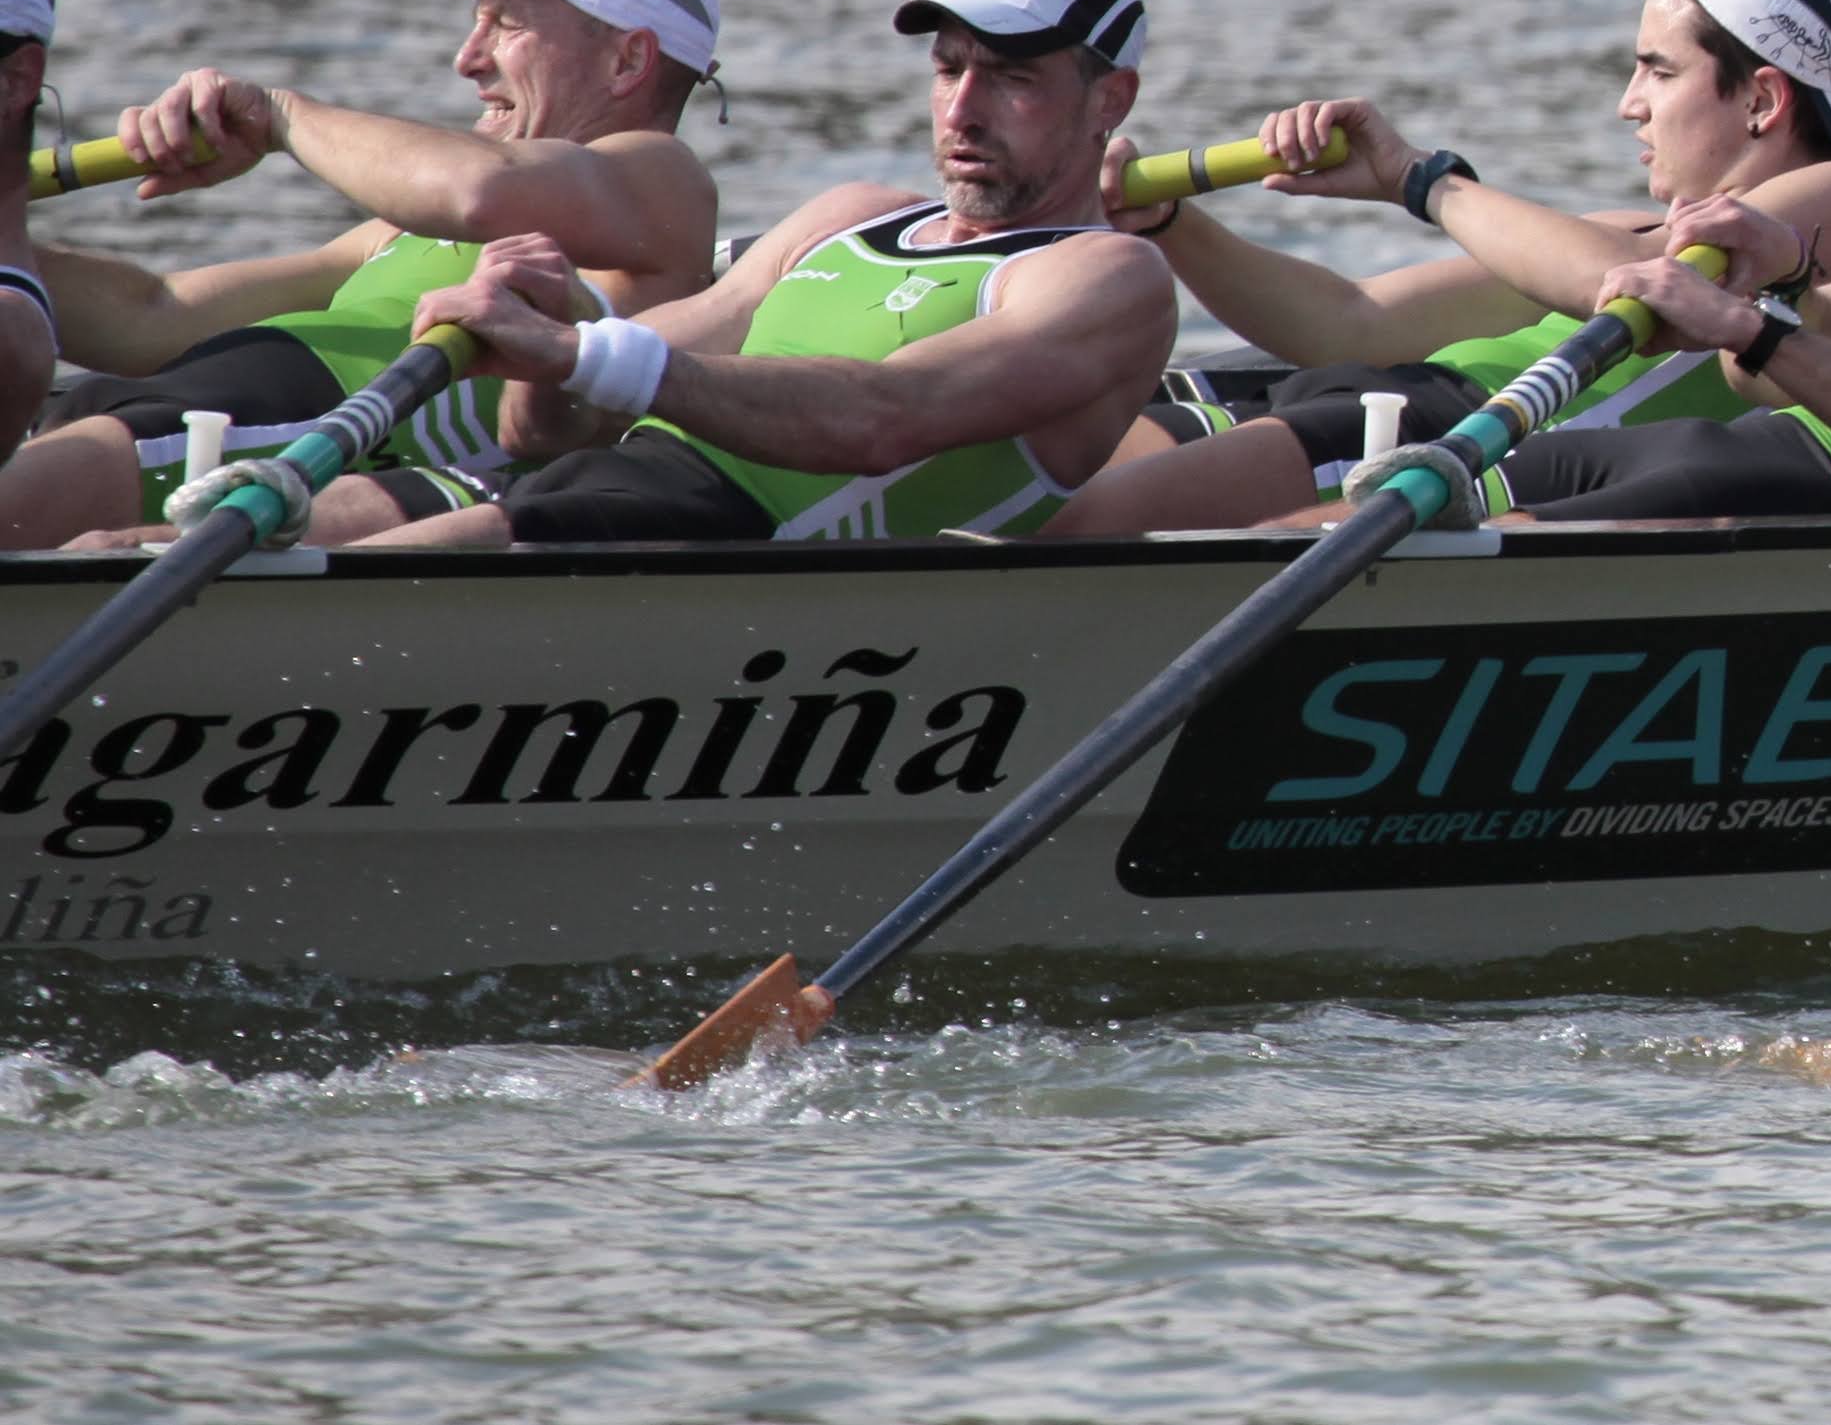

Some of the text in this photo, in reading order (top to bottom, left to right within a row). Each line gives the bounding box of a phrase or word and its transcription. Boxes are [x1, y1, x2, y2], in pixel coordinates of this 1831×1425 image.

[1227, 815, 1368, 850] UNITING
[1372, 811, 1502, 845] PEOPLE
[1510, 809, 1564, 838] BY
[1560, 801, 1718, 838] DIVIDING
